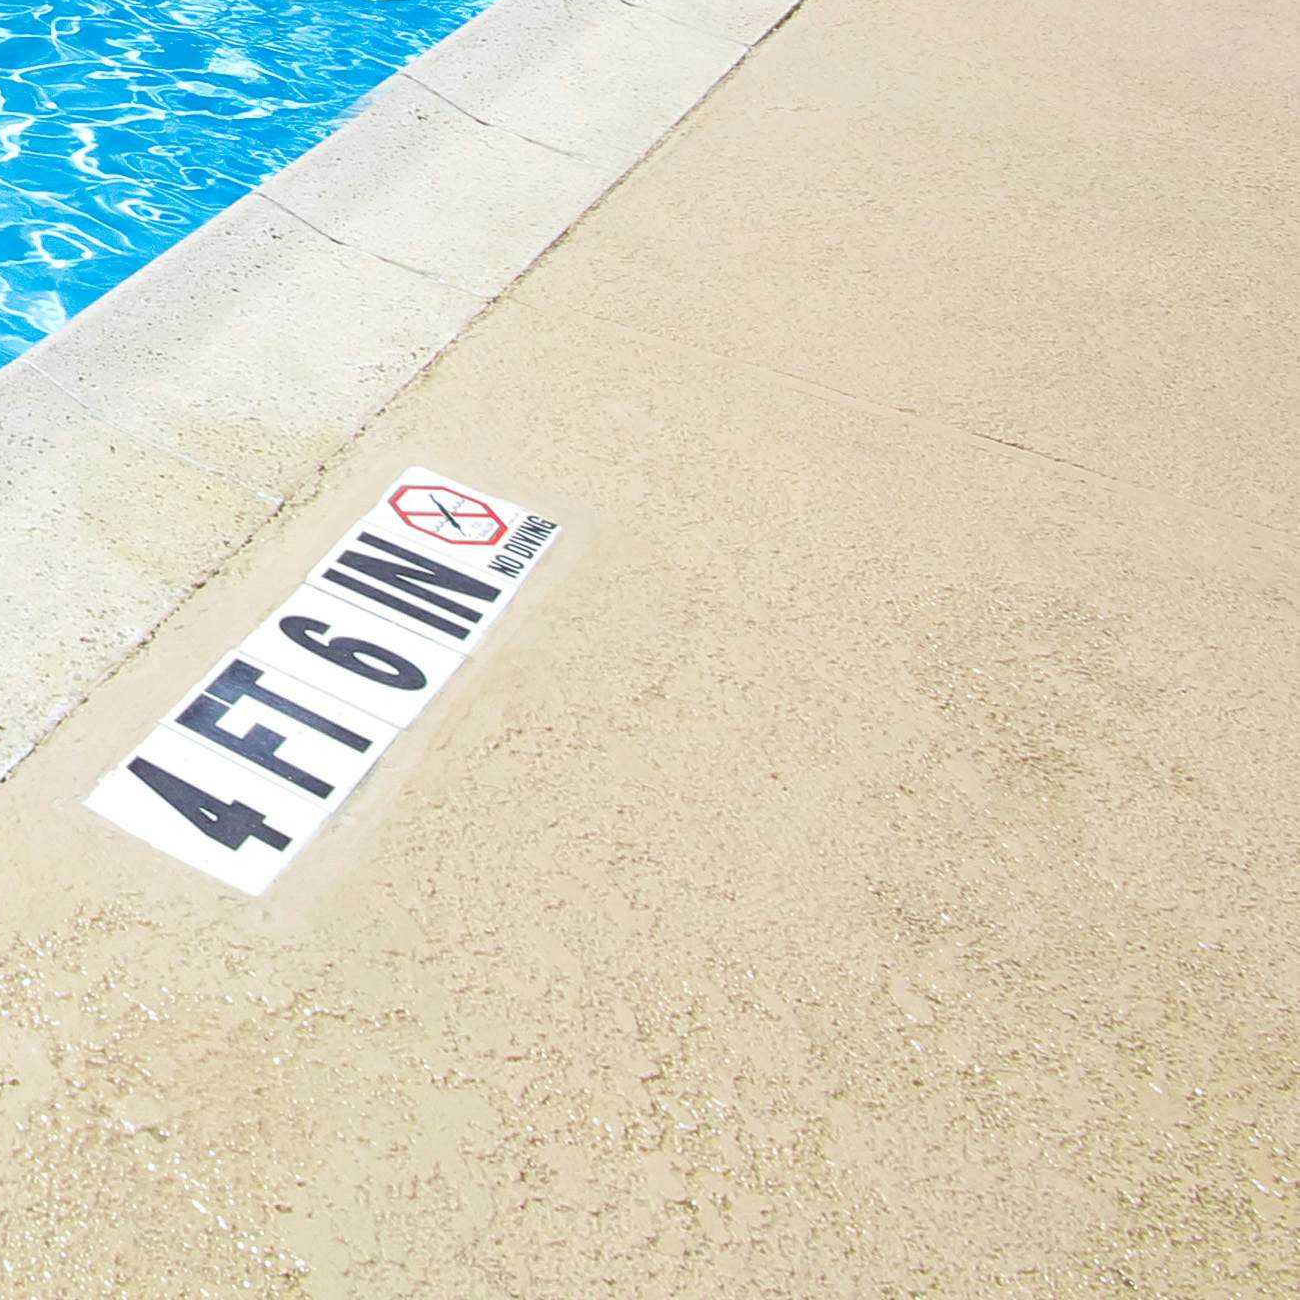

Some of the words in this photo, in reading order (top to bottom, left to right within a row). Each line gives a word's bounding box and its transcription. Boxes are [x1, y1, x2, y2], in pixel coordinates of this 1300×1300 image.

[487, 554, 526, 579] NO
[503, 515, 559, 560] DIVING
[321, 531, 502, 641] IN
[279, 615, 428, 691] 6
[174, 658, 373, 800] FT
[126, 756, 293, 852] 4
